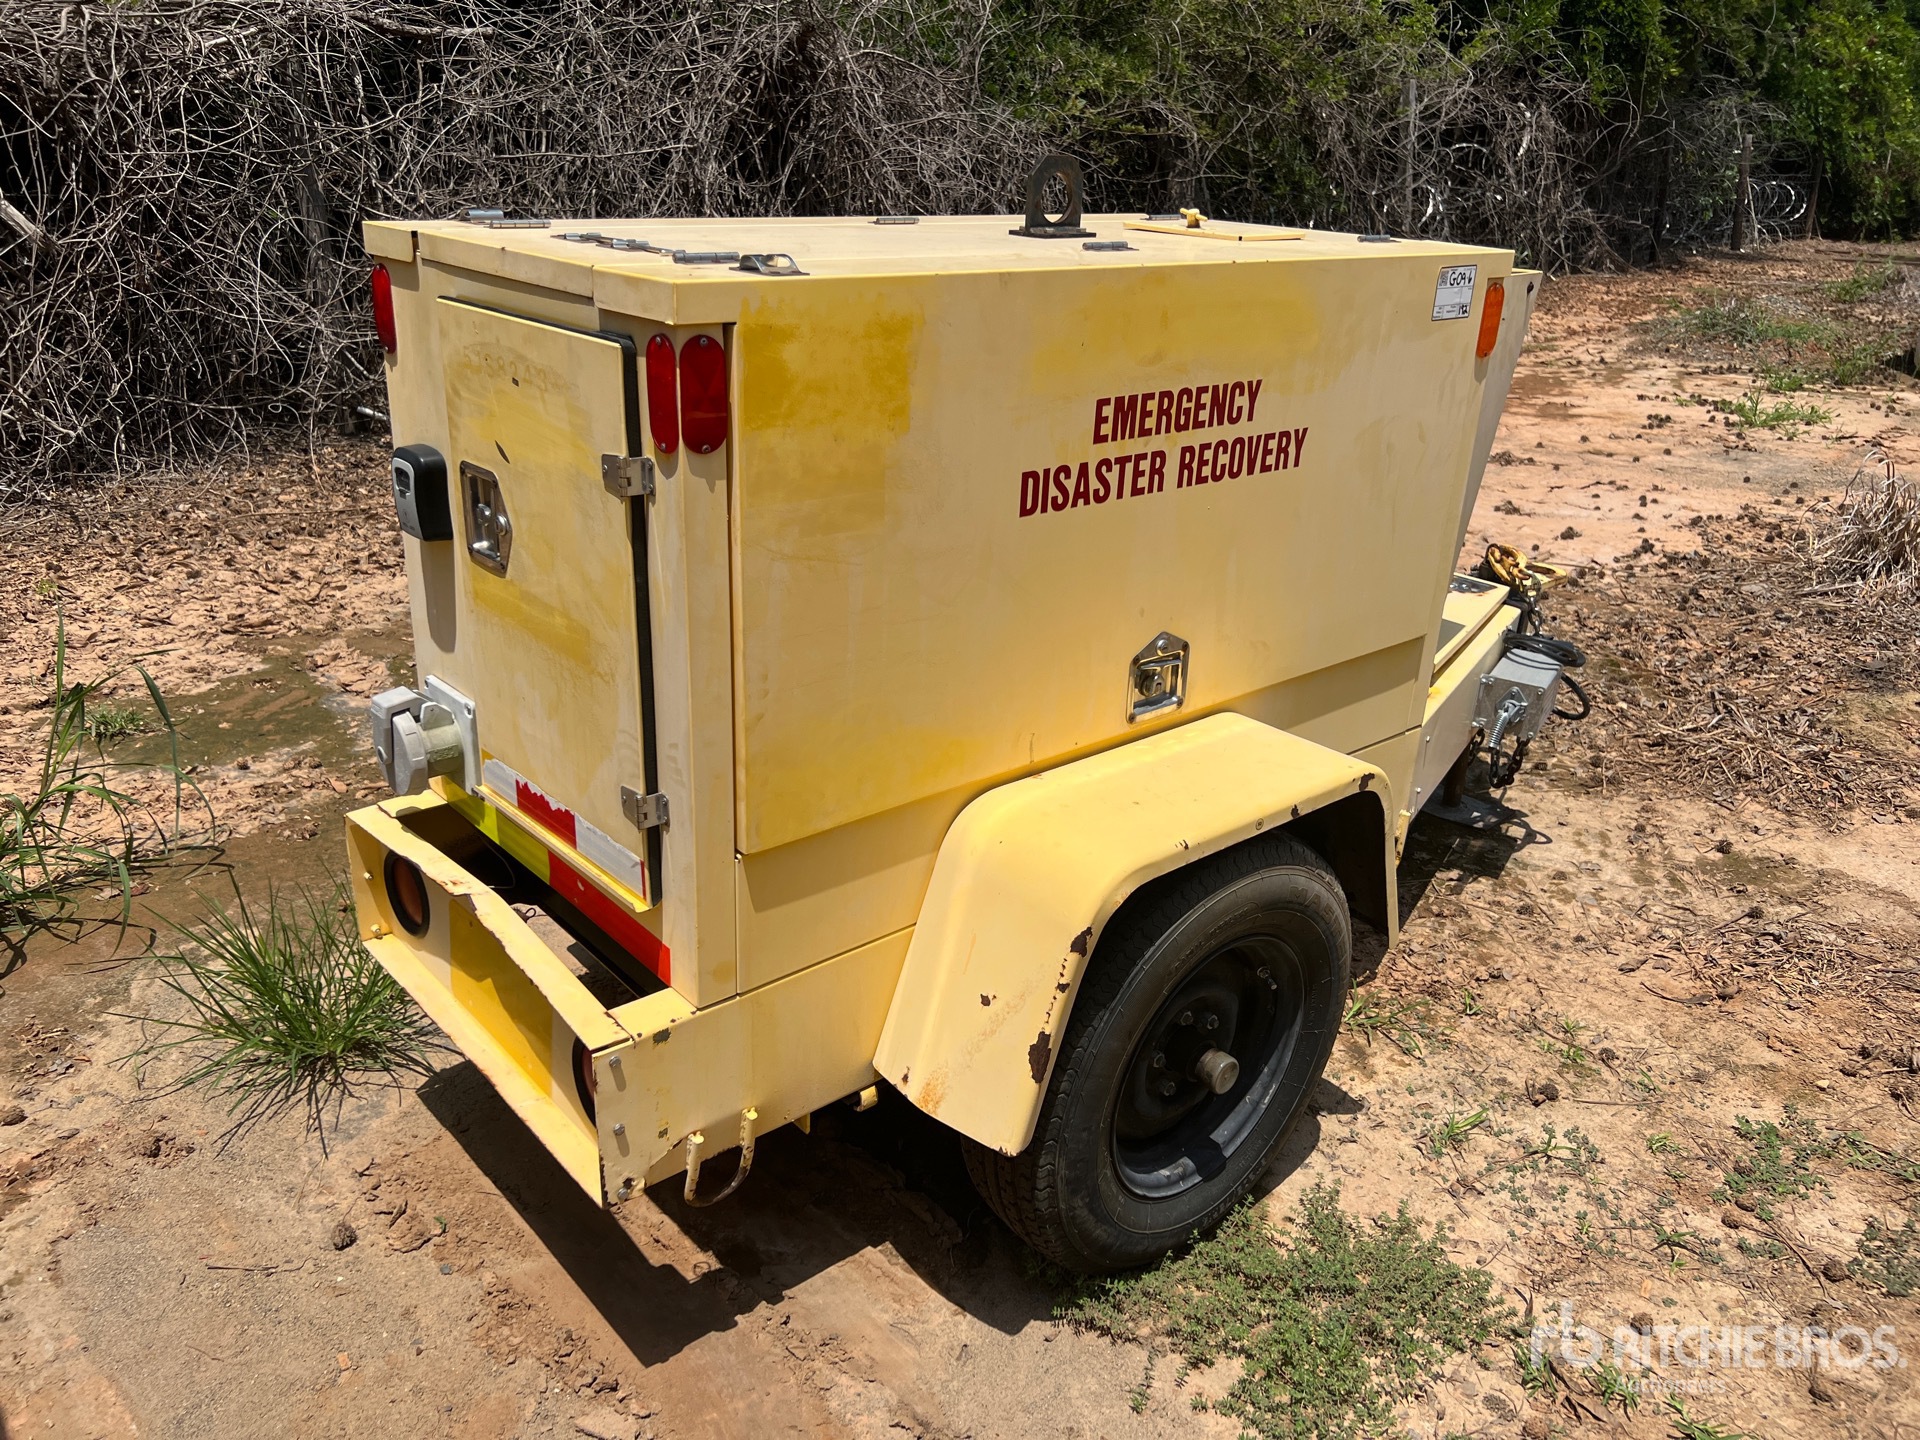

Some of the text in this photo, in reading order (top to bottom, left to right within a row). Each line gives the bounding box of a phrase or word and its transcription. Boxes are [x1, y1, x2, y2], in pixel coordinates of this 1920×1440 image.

[1092, 378, 1263, 445] EMERGENCY
[1018, 426, 1309, 518] DISASTER RECOVERY
